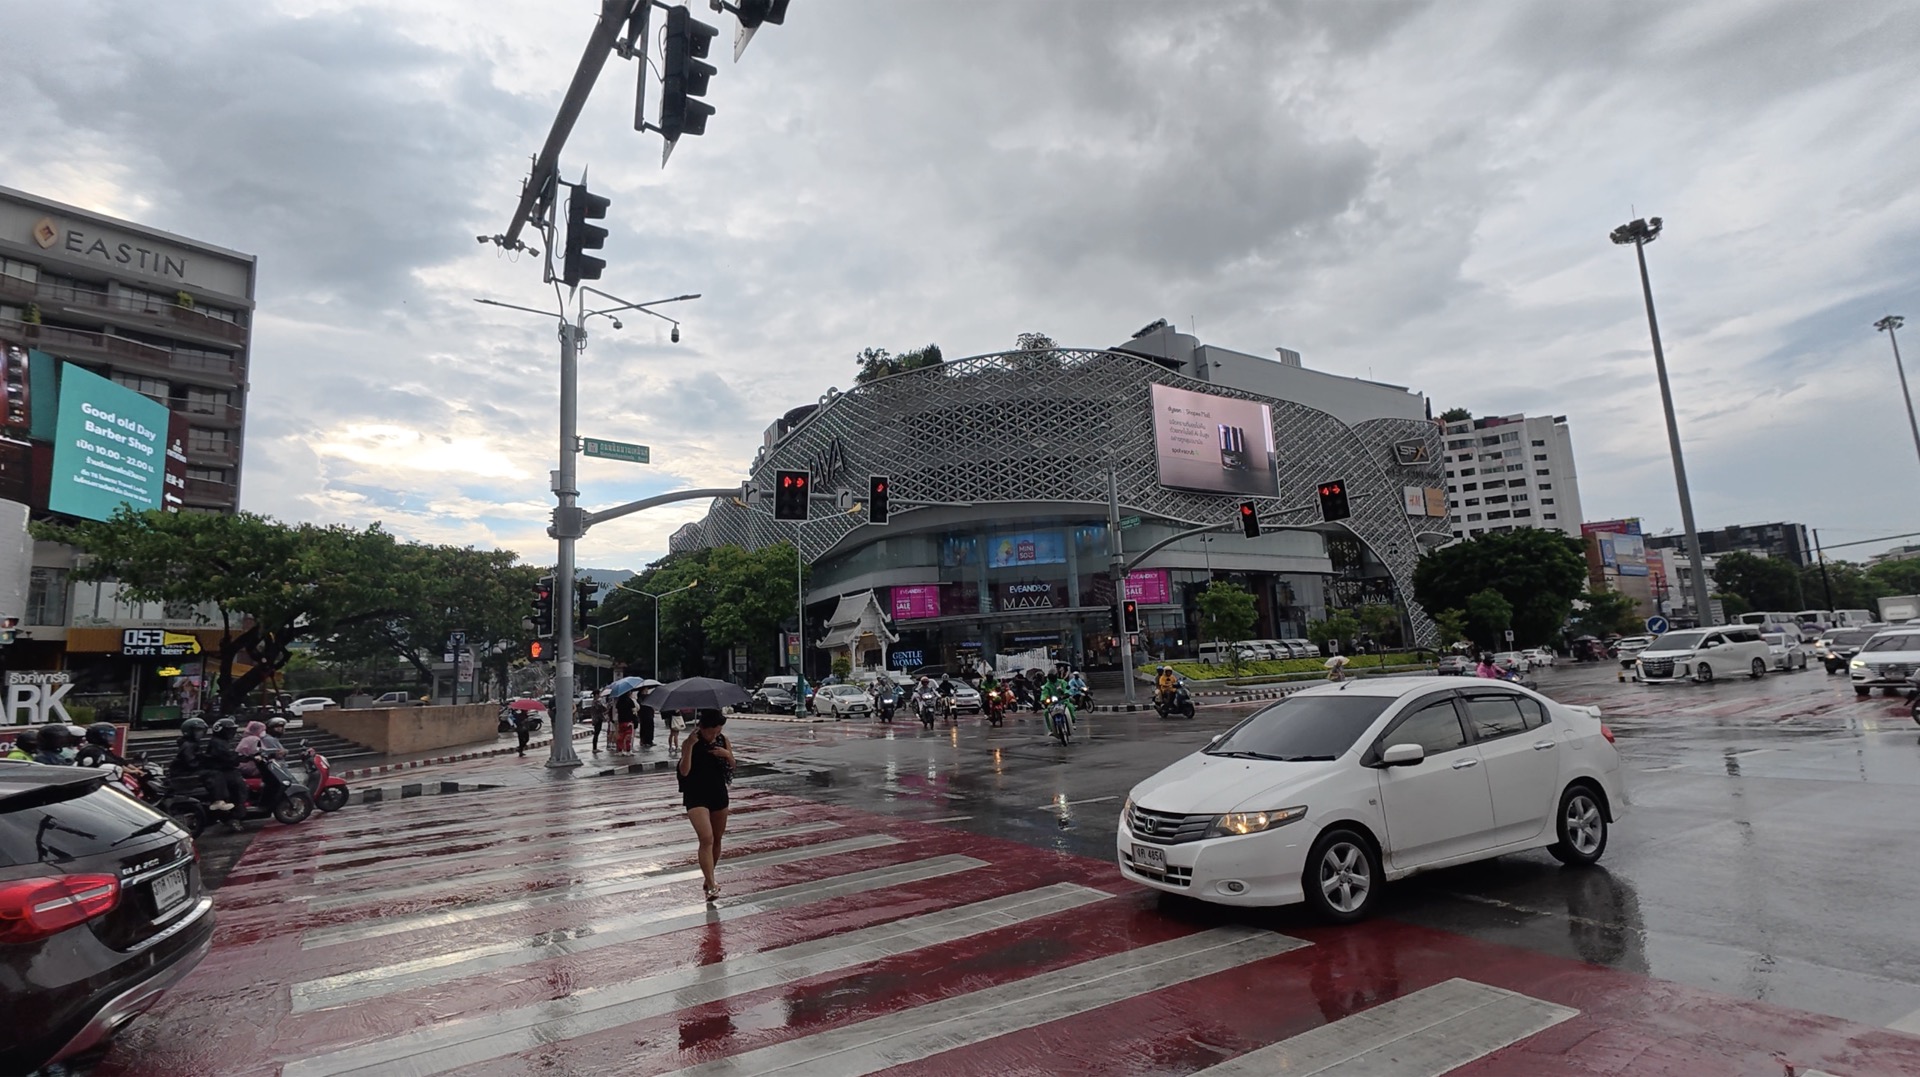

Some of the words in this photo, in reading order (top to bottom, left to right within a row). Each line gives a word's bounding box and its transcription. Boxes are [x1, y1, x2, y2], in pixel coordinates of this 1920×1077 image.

[65, 230, 186, 279] EASTIN
[81, 402, 115, 423] Good
[117, 418, 136, 432] old
[136, 424, 157, 441] Day
[84, 420, 127, 444] Barber
[127, 437, 154, 457] Shop
[76, 438, 95, 452] เปิด
[95, 445, 120, 460] 10.00
[126, 456, 148, 471] 22.00
[1400, 445, 1427, 461] SFX
[1009, 583, 1052, 594] EVEANDBOY
[1003, 595, 1053, 610] MAYA
[1361, 593, 1388, 605] MAYA
[896, 602, 911, 610] SALE
[124, 629, 165, 646] 053
[123, 647, 156, 655] Craft
[161, 646, 185, 655] beer
[892, 650, 923, 659] GENTLE
[892, 658, 923, 667] WOMAN
[122, 864, 143, 876] GLA
